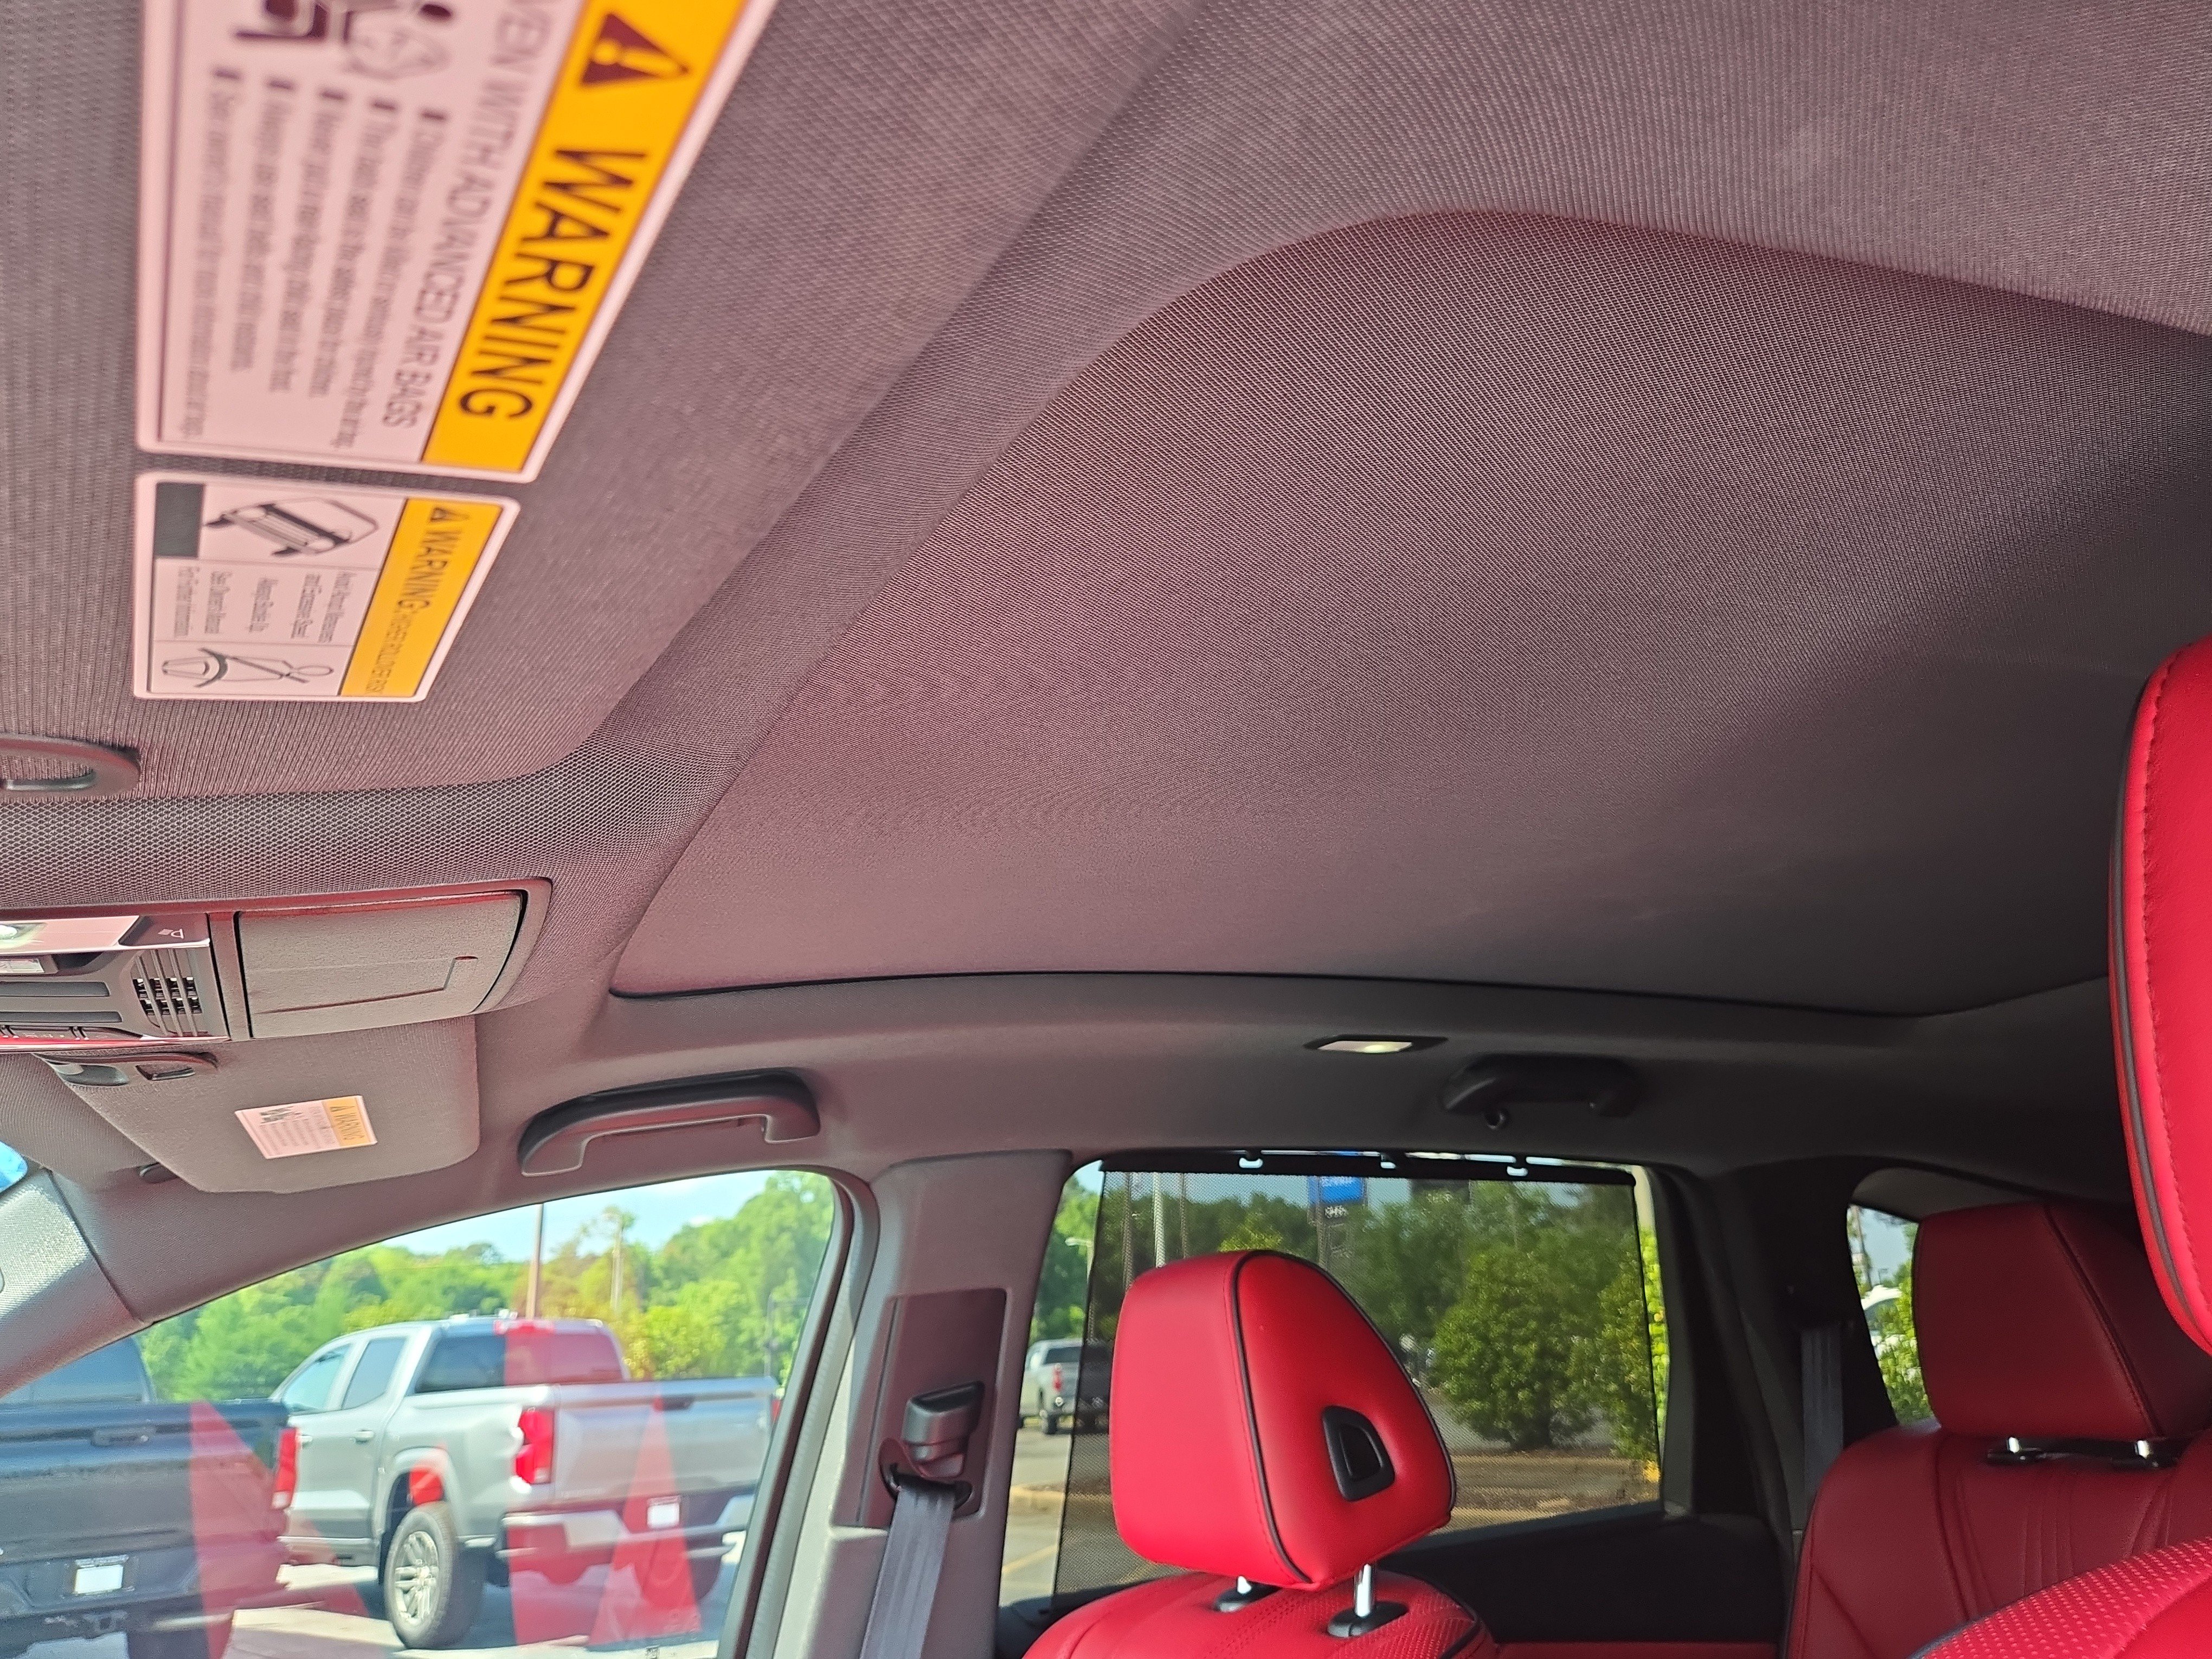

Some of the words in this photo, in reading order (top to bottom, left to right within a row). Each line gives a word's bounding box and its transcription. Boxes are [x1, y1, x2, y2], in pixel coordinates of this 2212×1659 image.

[461, 83, 528, 166] WITH
[414, 172, 498, 320] ADVANCED
[461, 149, 645, 421] WARNING
[401, 326, 445, 364] AIR
[382, 371, 430, 427] BAGS
